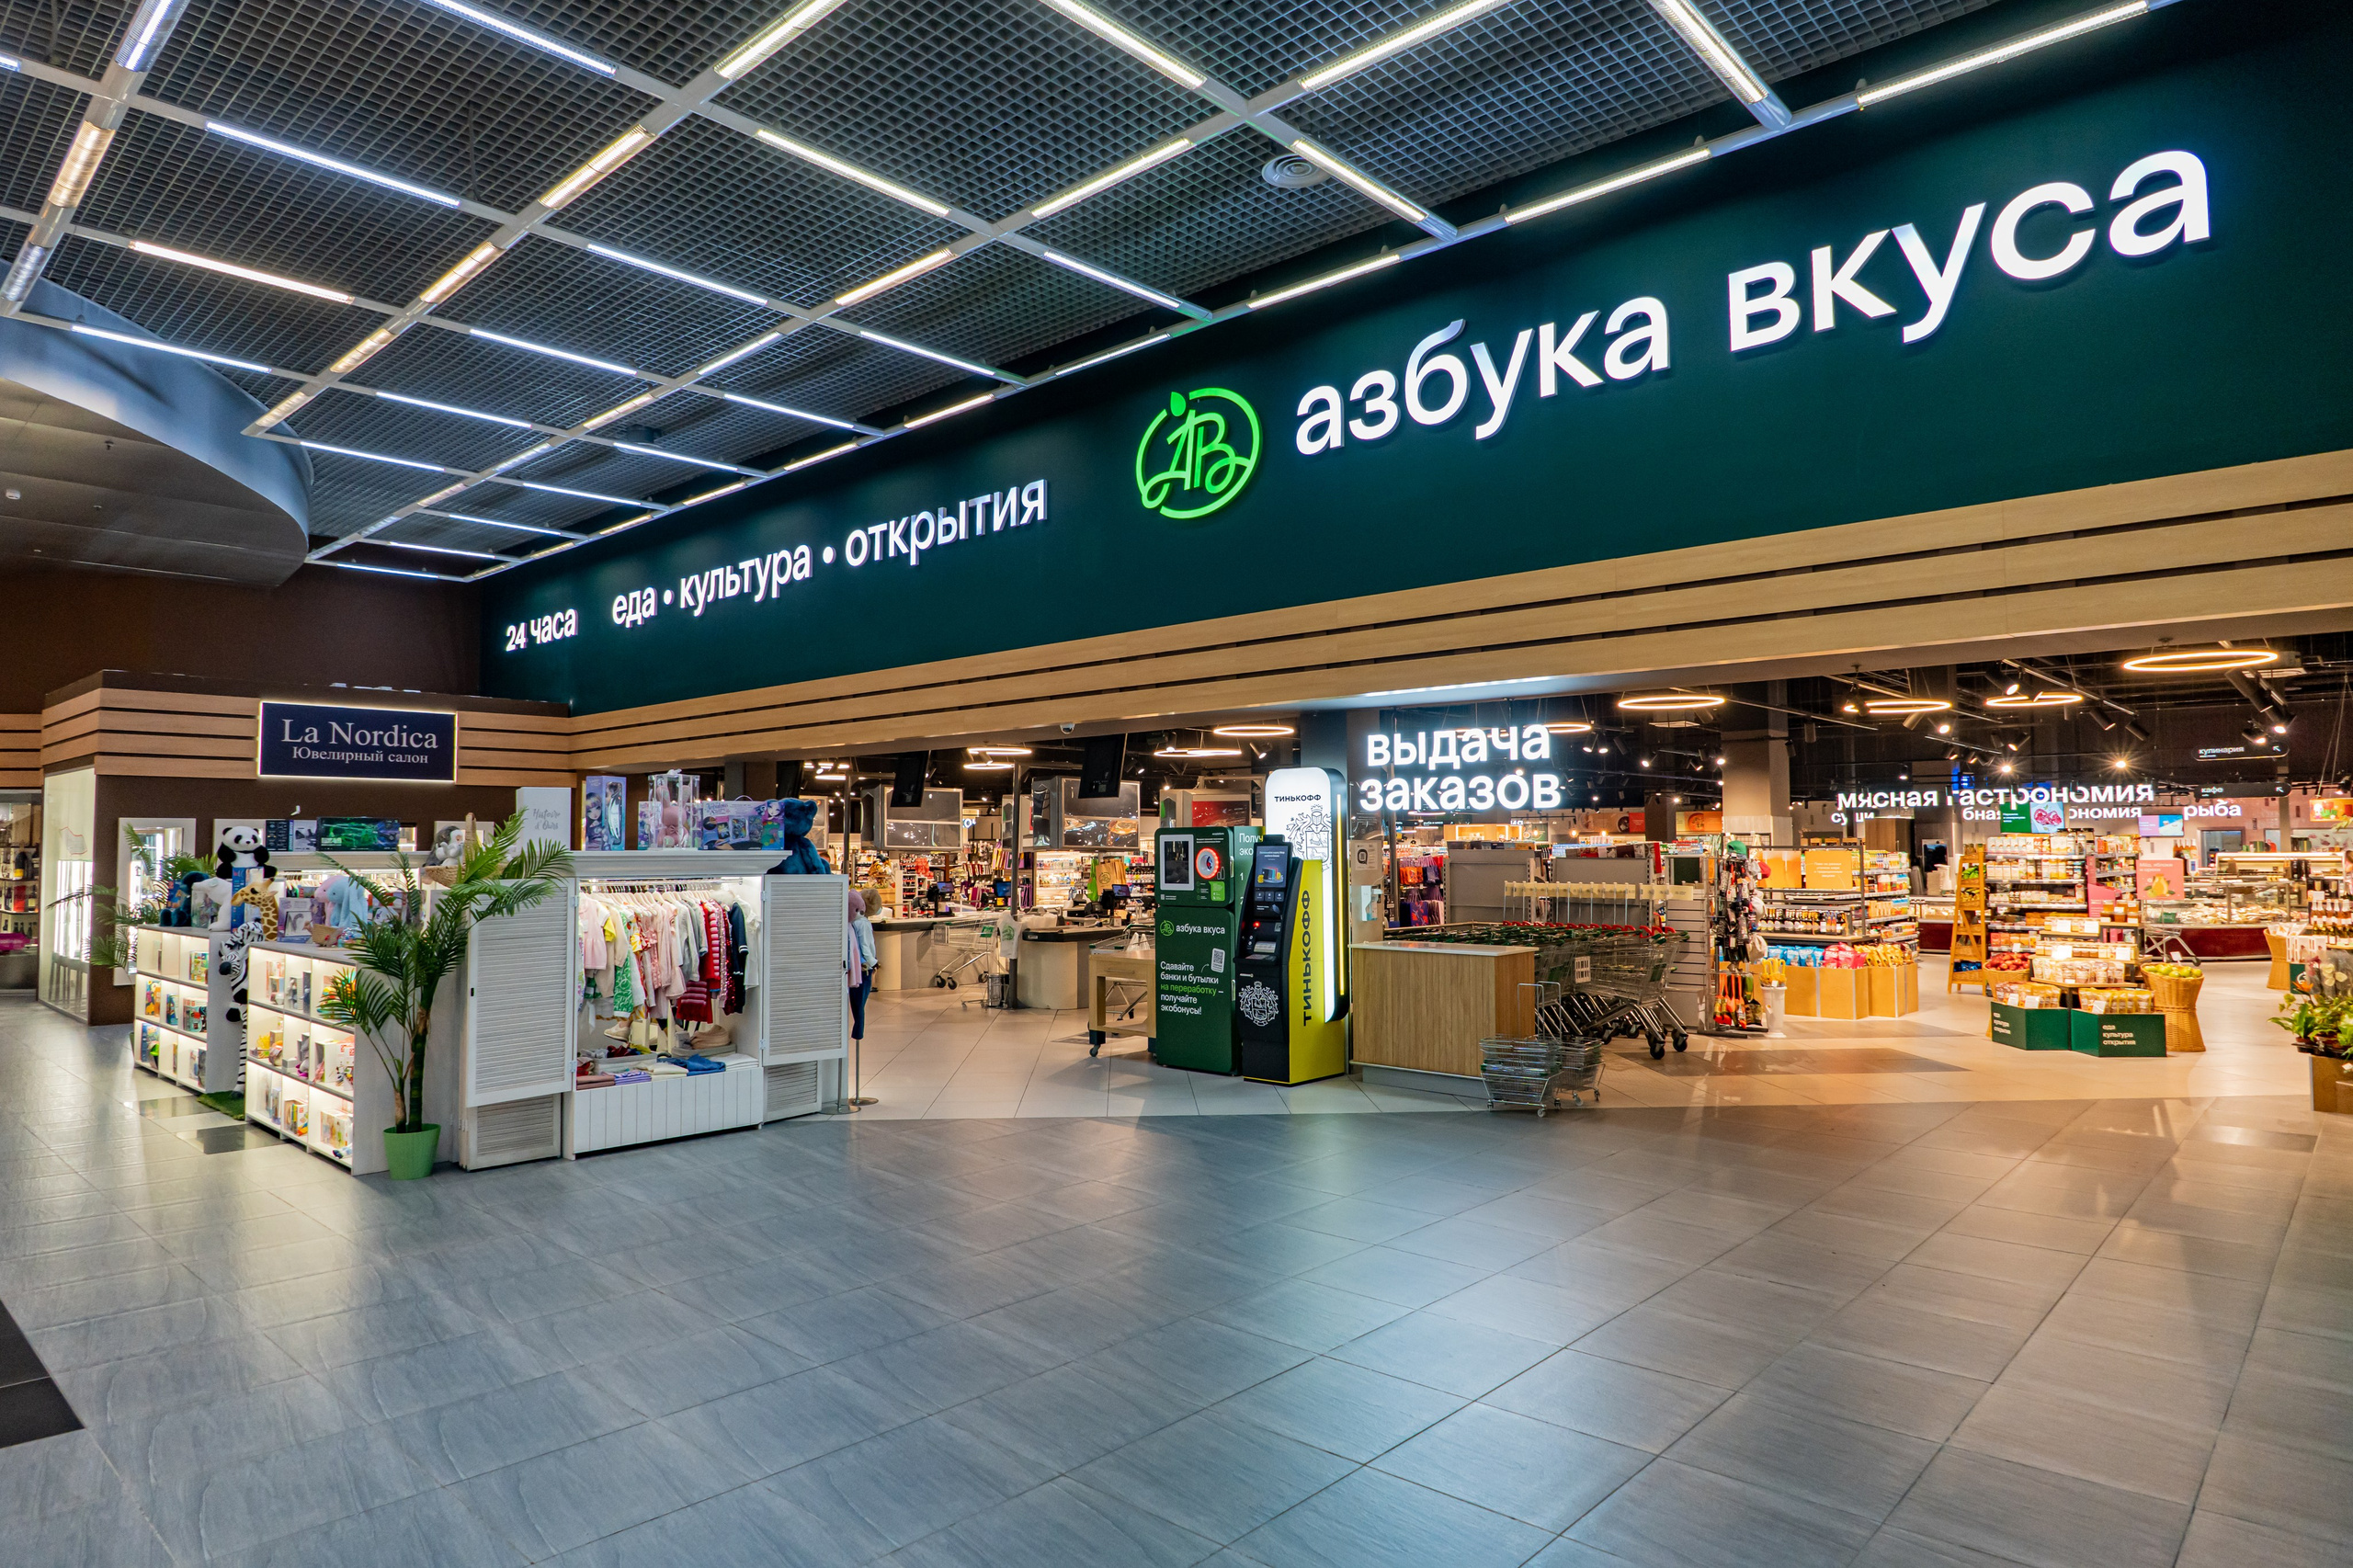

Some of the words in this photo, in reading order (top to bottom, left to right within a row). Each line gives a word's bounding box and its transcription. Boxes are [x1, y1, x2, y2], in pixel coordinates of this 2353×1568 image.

[1295, 296, 1670, 456] азбука
[1728, 149, 2211, 351] вкуса
[612, 586, 657, 628] еда
[680, 544, 813, 617] культура
[845, 478, 1048, 566] открытия
[506, 625, 529, 652] 24
[530, 608, 578, 644] часа
[281, 719, 320, 744] La
[328, 722, 438, 749] Nordica
[292, 746, 384, 764] Ювелирный
[388, 753, 428, 764] салон
[1368, 723, 1551, 771] выдача
[1274, 794, 1322, 802] ТИНЬКОФФ
[1360, 773, 1561, 812] заказов
[1837, 790, 1938, 810] мясная
[2183, 799, 2242, 821] рыба
[1176, 923, 1201, 935] азбука
[1203, 926, 1225, 936] вкуса
[1160, 960, 1194, 971] Сдавайте
[1302, 890, 1312, 1027] ТИНЬКОФФ
[1160, 971, 1181, 982] банки
[1188, 974, 1219, 984] бутылки
[1160, 994, 1198, 1004] получайте
[1170, 984, 1217, 996] переработку
[1160, 1004, 1202, 1015] экобонусы!
